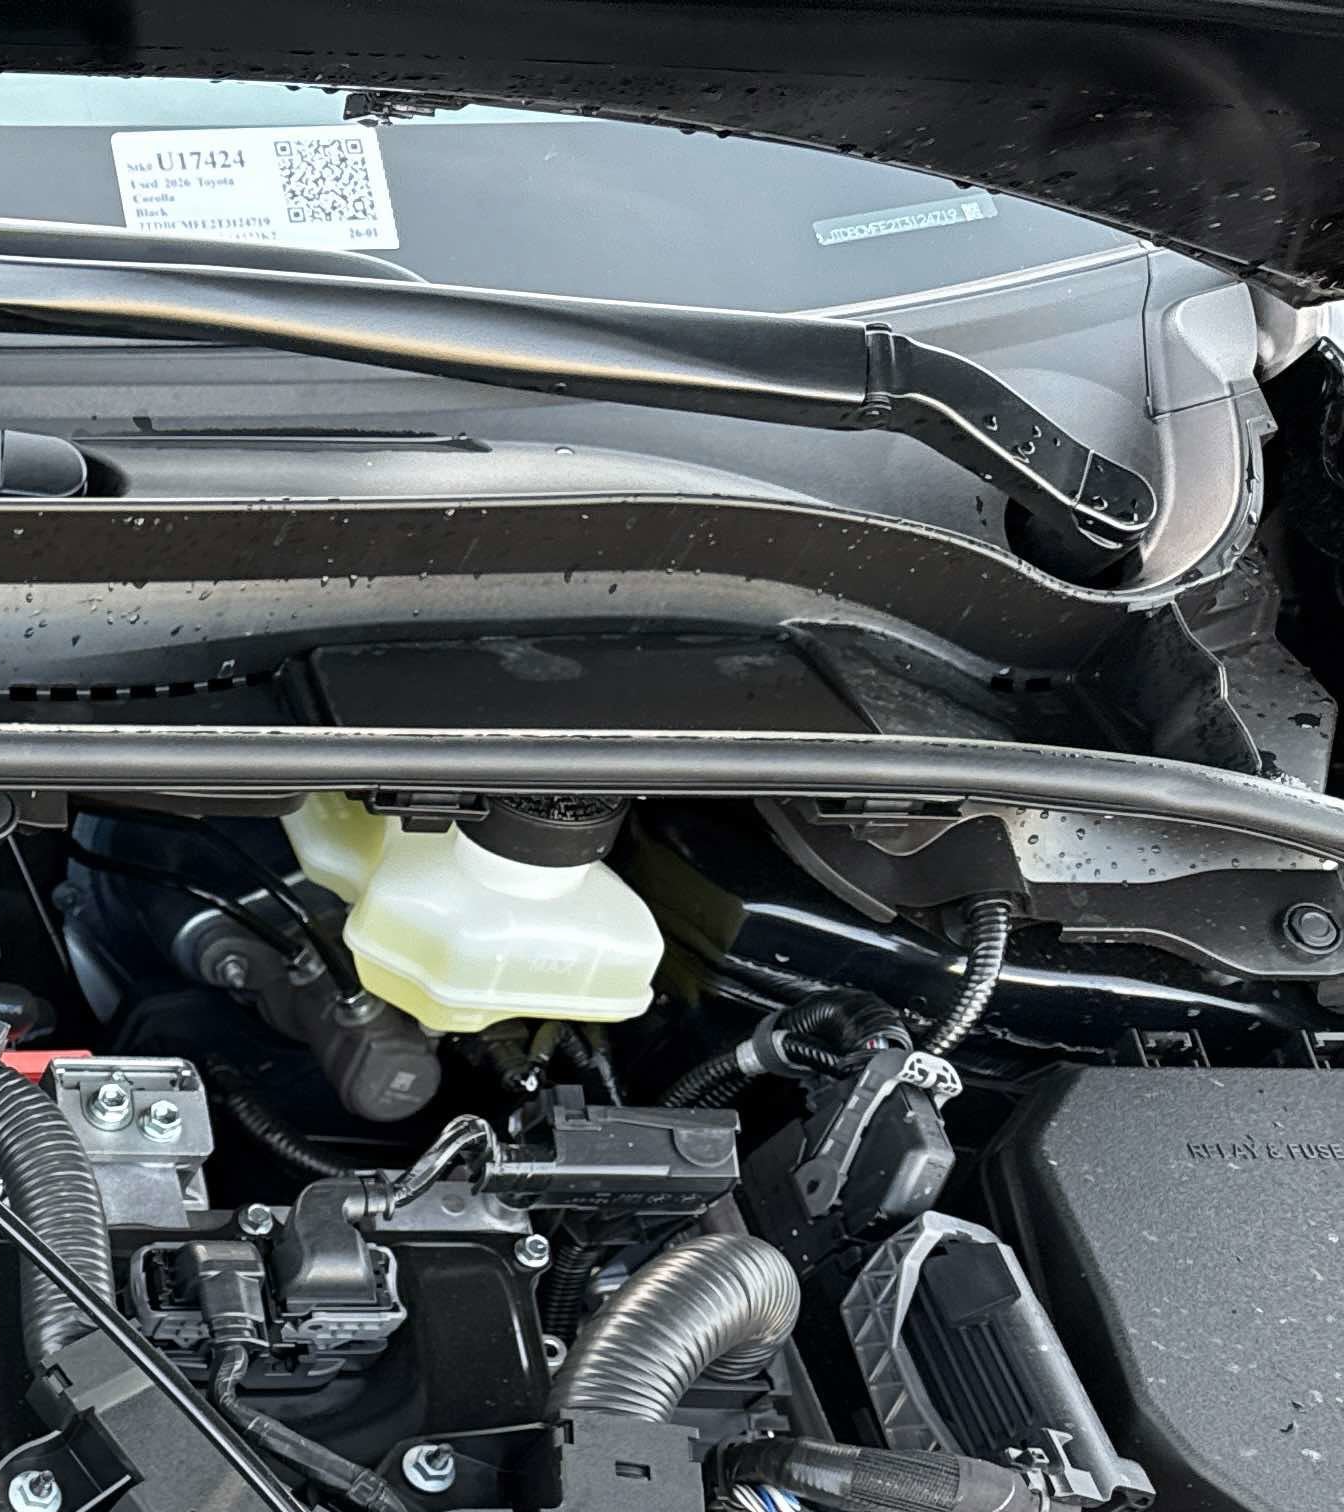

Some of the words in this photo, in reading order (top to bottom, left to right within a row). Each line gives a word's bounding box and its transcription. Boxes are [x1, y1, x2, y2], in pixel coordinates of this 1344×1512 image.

[157, 150, 246, 172] U17424
[165, 177, 191, 188] 2026
[198, 176, 235, 189] Toyota
[133, 193, 175, 204] Corolla
[136, 207, 169, 218] Black
[1186, 1142, 1257, 1160] RELAY
[1266, 1143, 1283, 1160] &
[1286, 1143, 1344, 1160] FUSE
